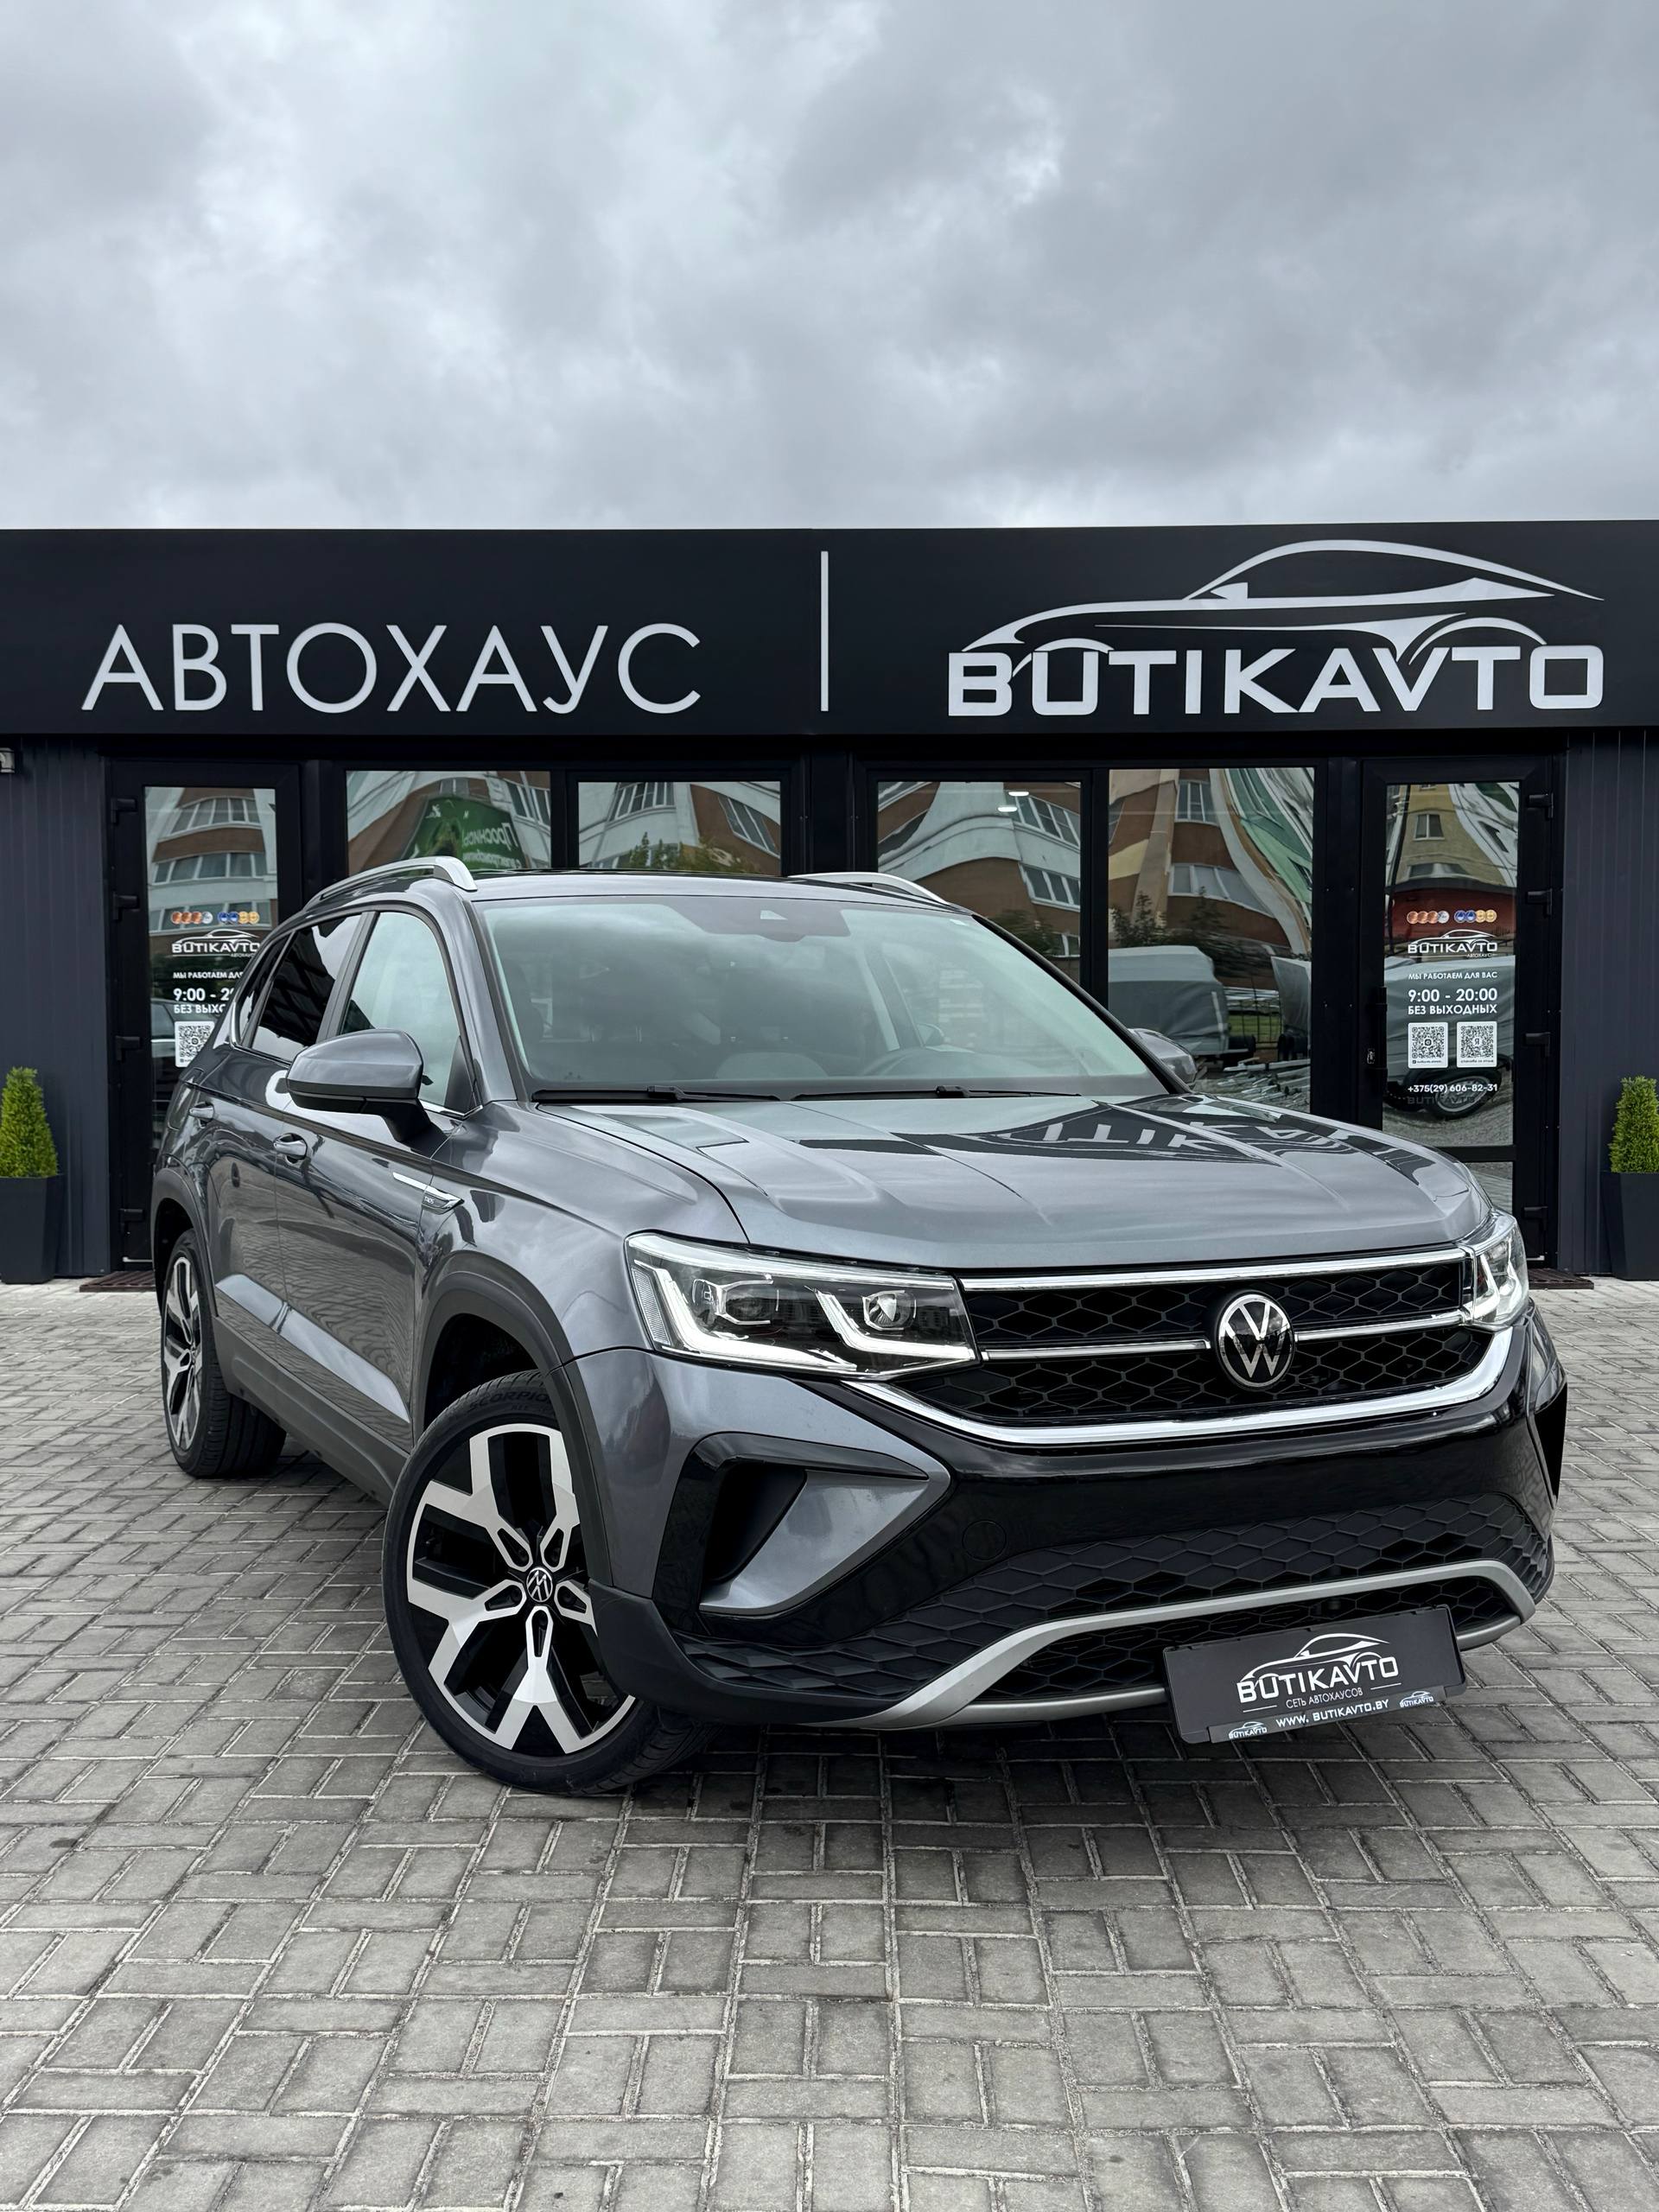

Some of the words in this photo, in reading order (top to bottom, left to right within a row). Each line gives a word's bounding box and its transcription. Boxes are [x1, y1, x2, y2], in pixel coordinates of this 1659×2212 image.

[81, 620, 702, 714] АВТОХАУС
[948, 645, 1605, 716] BUTIKAVTO
[171, 942, 261, 953] BUTIKAVTO
[1408, 942, 1497, 954] BUTIKAVTO
[173, 988, 206, 1001] 9:00
[220, 988, 234, 1001] 2
[1408, 988, 1440, 1002] 9:00
[1456, 988, 1498, 1001] 20:00
[174, 1004, 192, 1014] БЕЗ
[1408, 1005, 1427, 1014] БЕЗ
[1429, 1004, 1497, 1015] ВЫХОДНЫХ
[1408, 1084, 1448, 1093] +375(29)
[1449, 1083, 1498, 1092] 606-82-31
[1236, 1656, 1399, 1703] BUTIKAVTO
[1286, 1697, 1306, 1709] СЕТЬ
[1308, 1688, 1363, 1705] АВТОХАУСОВ
[1399, 1694, 1434, 1708] BUTIKAVTO
[1276, 1714, 1310, 1727] WWW.
[1313, 1699, 1389, 1721] BUTIKAVTO.BY
[1229, 1726, 1268, 1739] BUTIKAVTO
